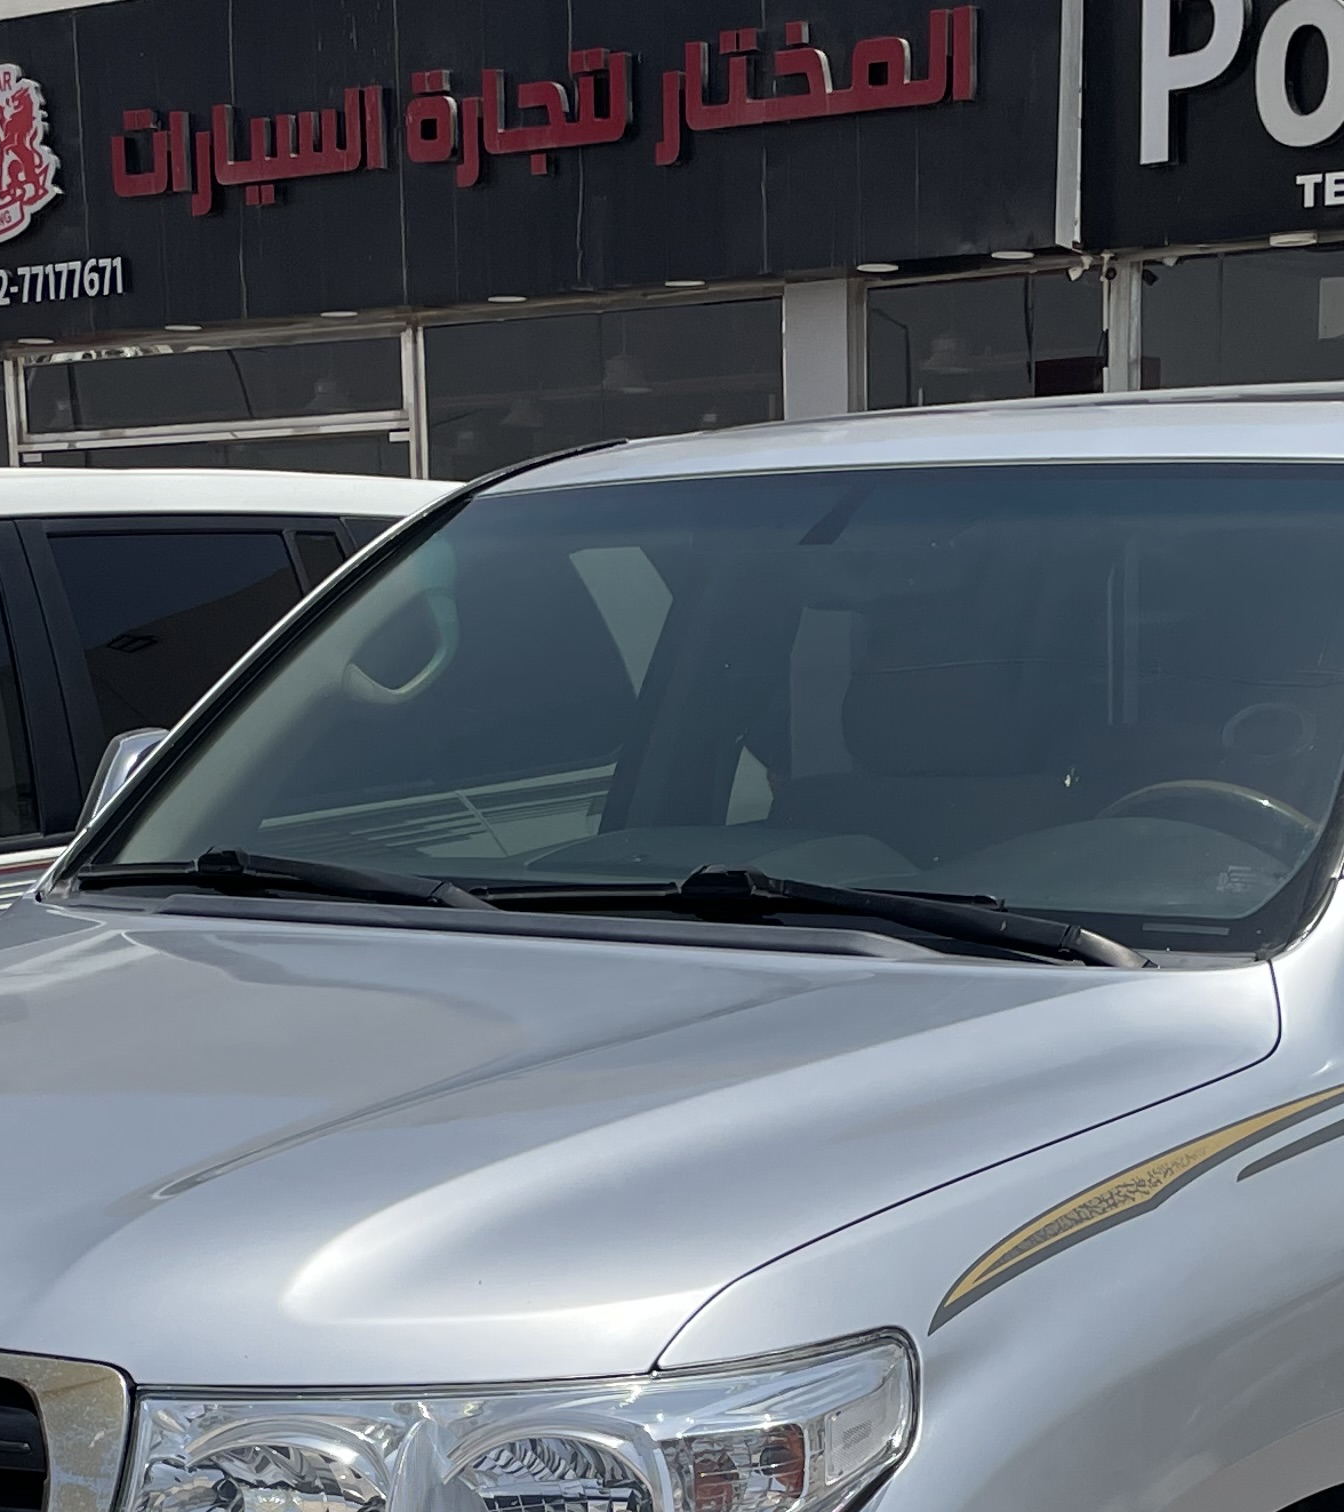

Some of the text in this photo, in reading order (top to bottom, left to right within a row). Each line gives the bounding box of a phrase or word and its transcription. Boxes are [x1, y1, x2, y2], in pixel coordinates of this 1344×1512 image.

[112, 5, 978, 216] المختار لتجارة السيارات
